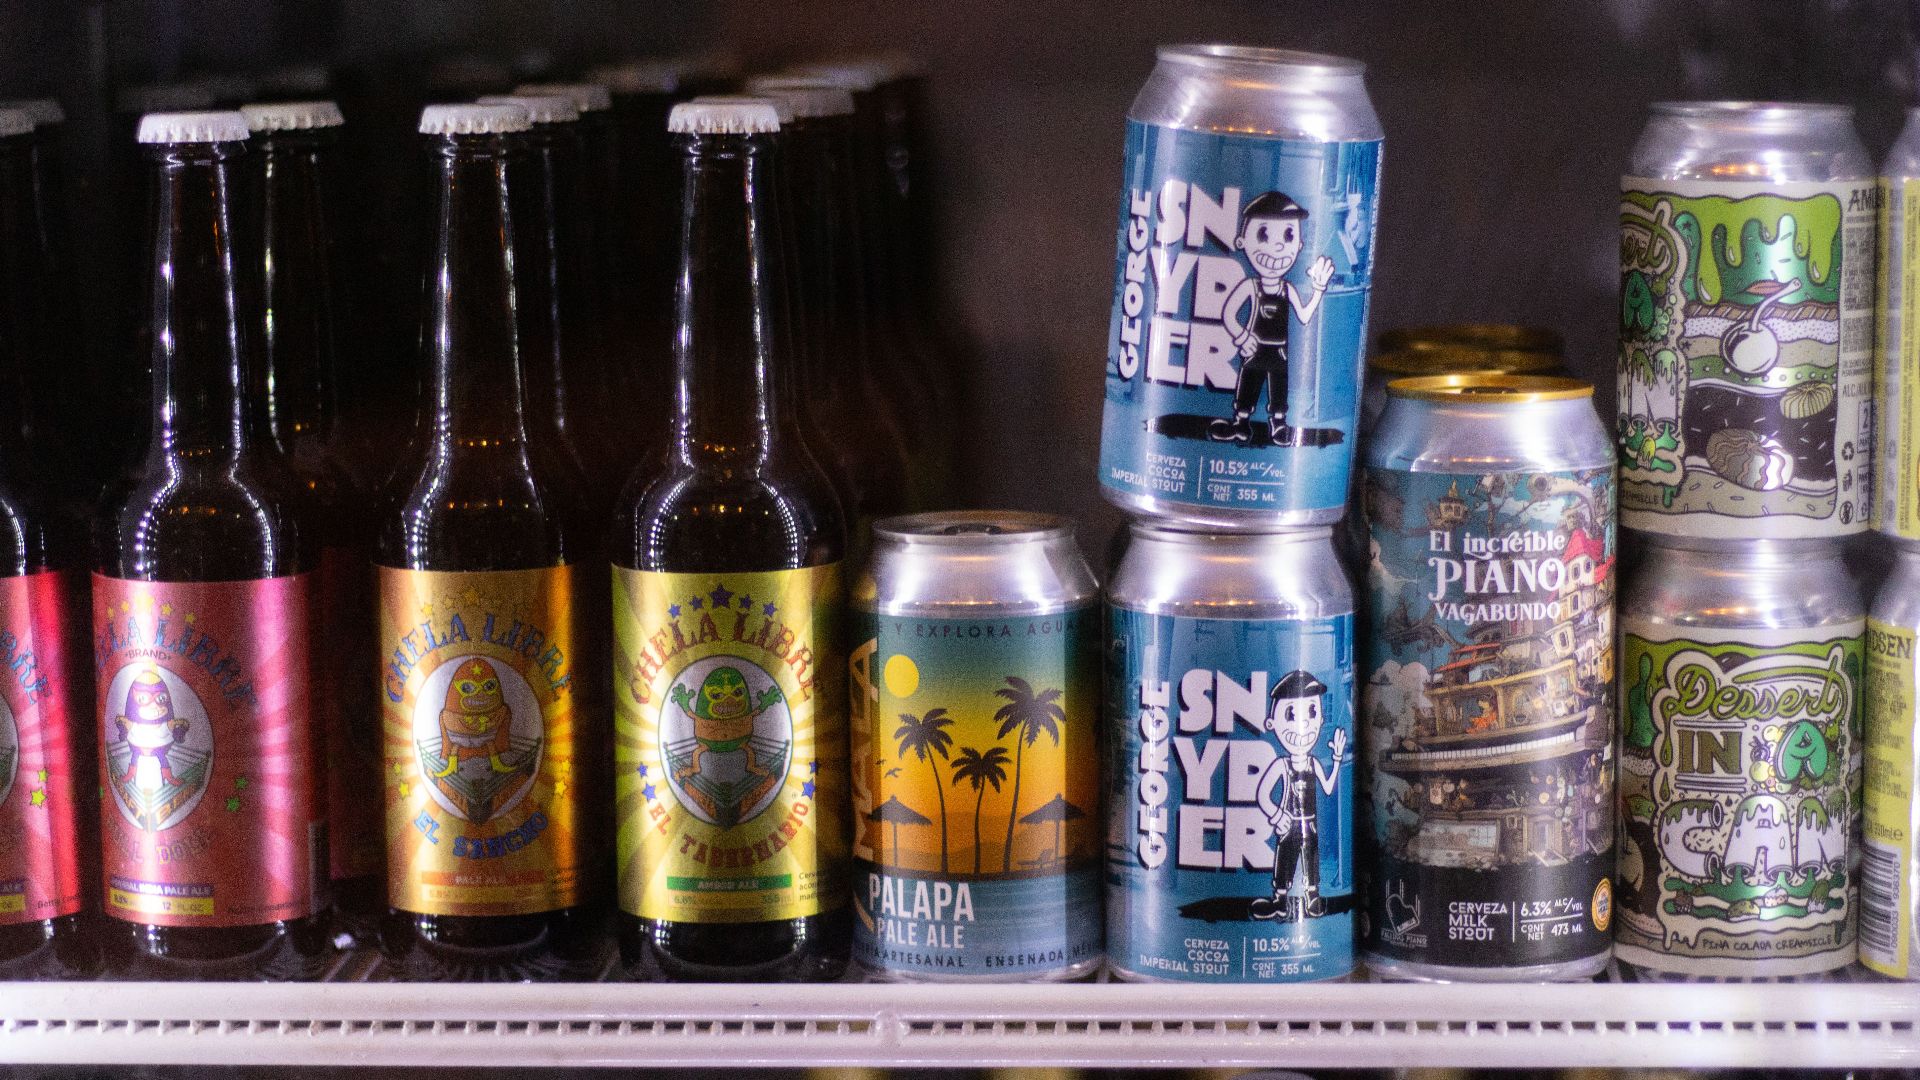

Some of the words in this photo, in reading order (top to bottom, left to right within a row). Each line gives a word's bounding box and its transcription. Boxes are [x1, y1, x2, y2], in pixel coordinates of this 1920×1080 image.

[1119, 188, 1152, 379] GEORGE
[1147, 453, 1187, 467] CERVEZA
[1210, 459, 1248, 476] 10.5%
[1112, 467, 1148, 487] IMPERIAL
[1152, 479, 1186, 493] STOUT
[1149, 465, 1186, 480] COCOA
[1237, 489, 1258, 500] 355
[1429, 530, 1452, 552] El
[1463, 529, 1566, 560] increíble
[1427, 557, 1566, 601] PIANO
[1434, 602, 1562, 626] VAGABUNDO
[916, 625, 1012, 639] EXPLORA
[127, 649, 167, 661] BRAND
[386, 613, 471, 703] CHELA
[630, 612, 722, 705] CHELA
[1661, 654, 1848, 720] Dessert
[1677, 729, 1743, 775] IN
[1775, 719, 1829, 785] A
[1140, 681, 1170, 870] GEORGE
[649, 802, 672, 836] EL
[414, 810, 440, 845] EL
[453, 811, 549, 859] SANCHO
[1659, 794, 1847, 880] CAN
[164, 884, 189, 895] PALE
[191, 886, 210, 896] ALE
[868, 873, 975, 922] PALAPA
[163, 902, 171, 911] 12
[1449, 902, 1508, 914] CERVEZA
[1521, 901, 1551, 917] 6.3%
[1449, 914, 1487, 927] MILK
[1521, 923, 1544, 933] CONT
[877, 917, 917, 946] PALE
[927, 924, 965, 949] ALE
[1449, 927, 1495, 941] STOUT
[1527, 931, 1544, 940] NET
[1550, 923, 1569, 936] 473
[1572, 924, 1583, 933] ML
[1184, 938, 1230, 950] CERVEZA
[1252, 938, 1289, 952] 10.5%
[1733, 939, 1773, 951] COLADA
[1775, 935, 1833, 950] CREAMSICLE
[883, 951, 965, 968] ARTESANAL
[1188, 950, 1230, 962] COCOA
[1140, 954, 1188, 972] IMPERIAL
[1193, 964, 1230, 975] STOUT
[1281, 963, 1299, 975] 355
[1303, 964, 1314, 973] ML
